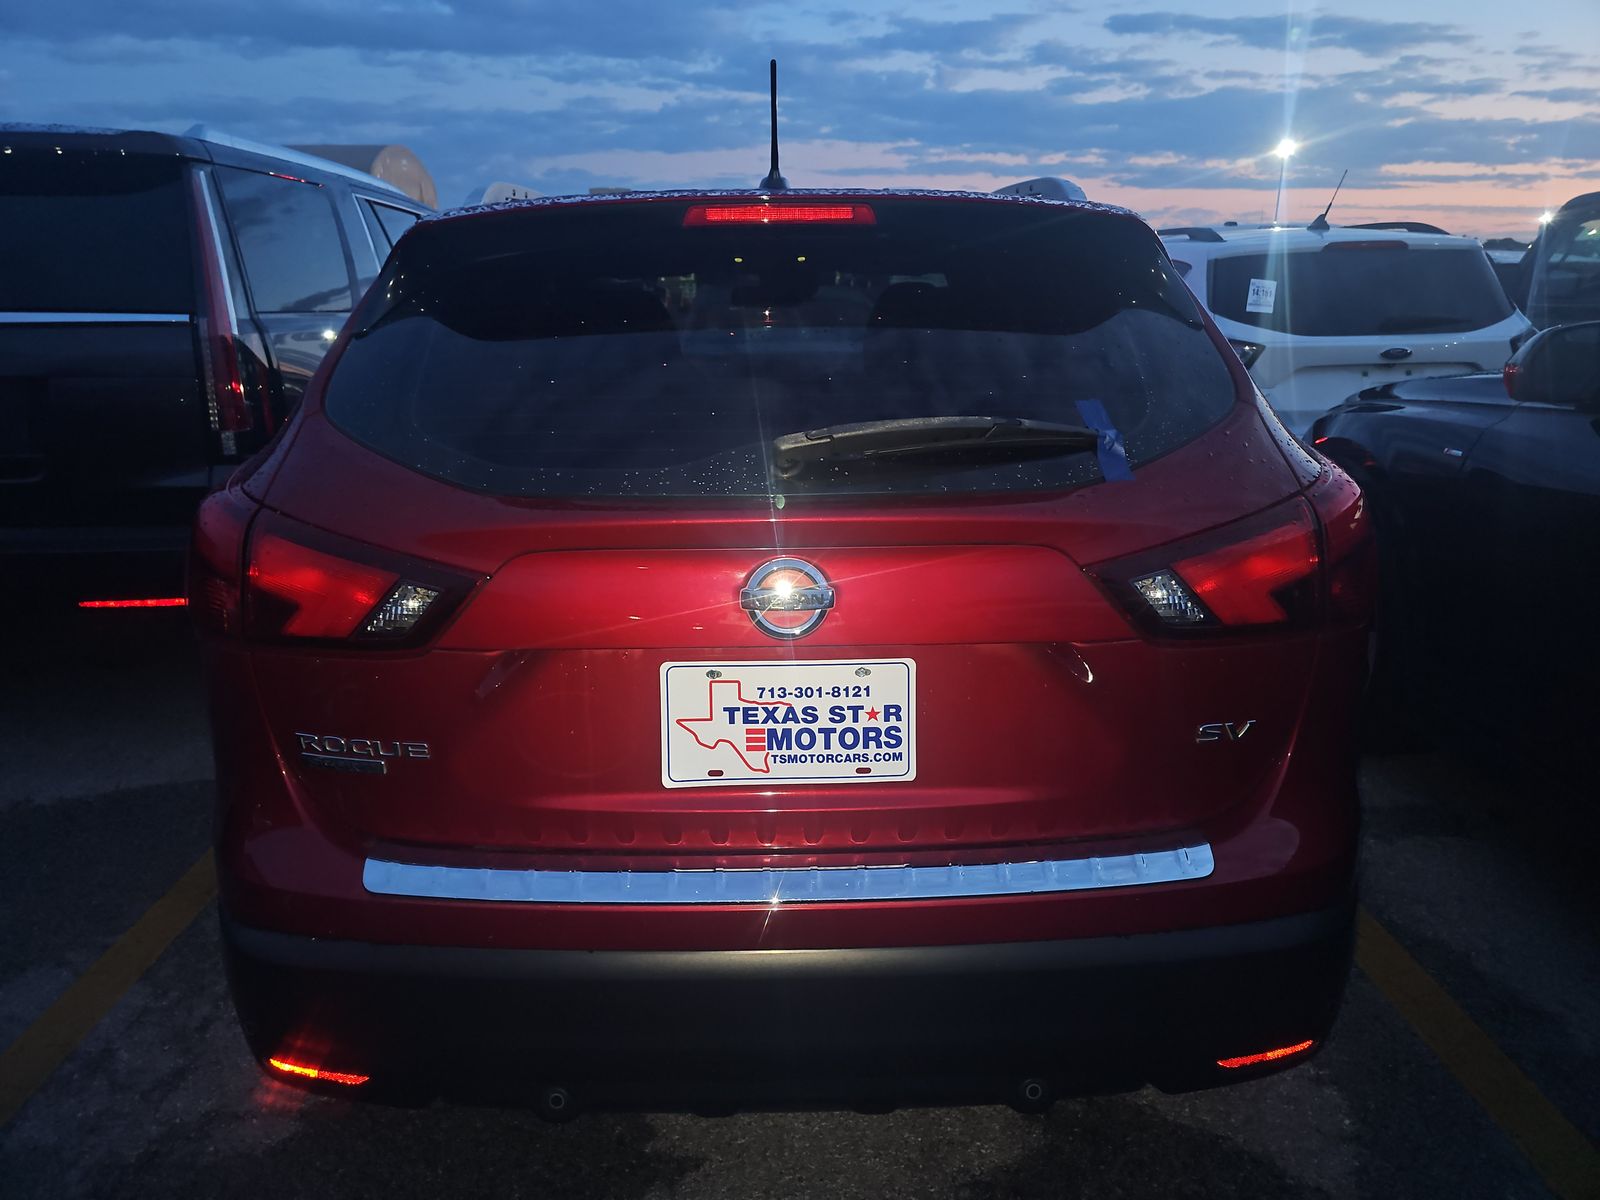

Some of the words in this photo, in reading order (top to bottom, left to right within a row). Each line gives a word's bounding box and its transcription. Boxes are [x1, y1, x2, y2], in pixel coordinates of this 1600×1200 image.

[757, 686, 871, 699] 713-301-8121
[723, 706, 819, 725] TEXAS
[767, 726, 903, 751] MOTORS
[1196, 720, 1257, 743] SV
[295, 732, 430, 758] ROGUE
[771, 752, 903, 764] TSMOTORCARS.COM
